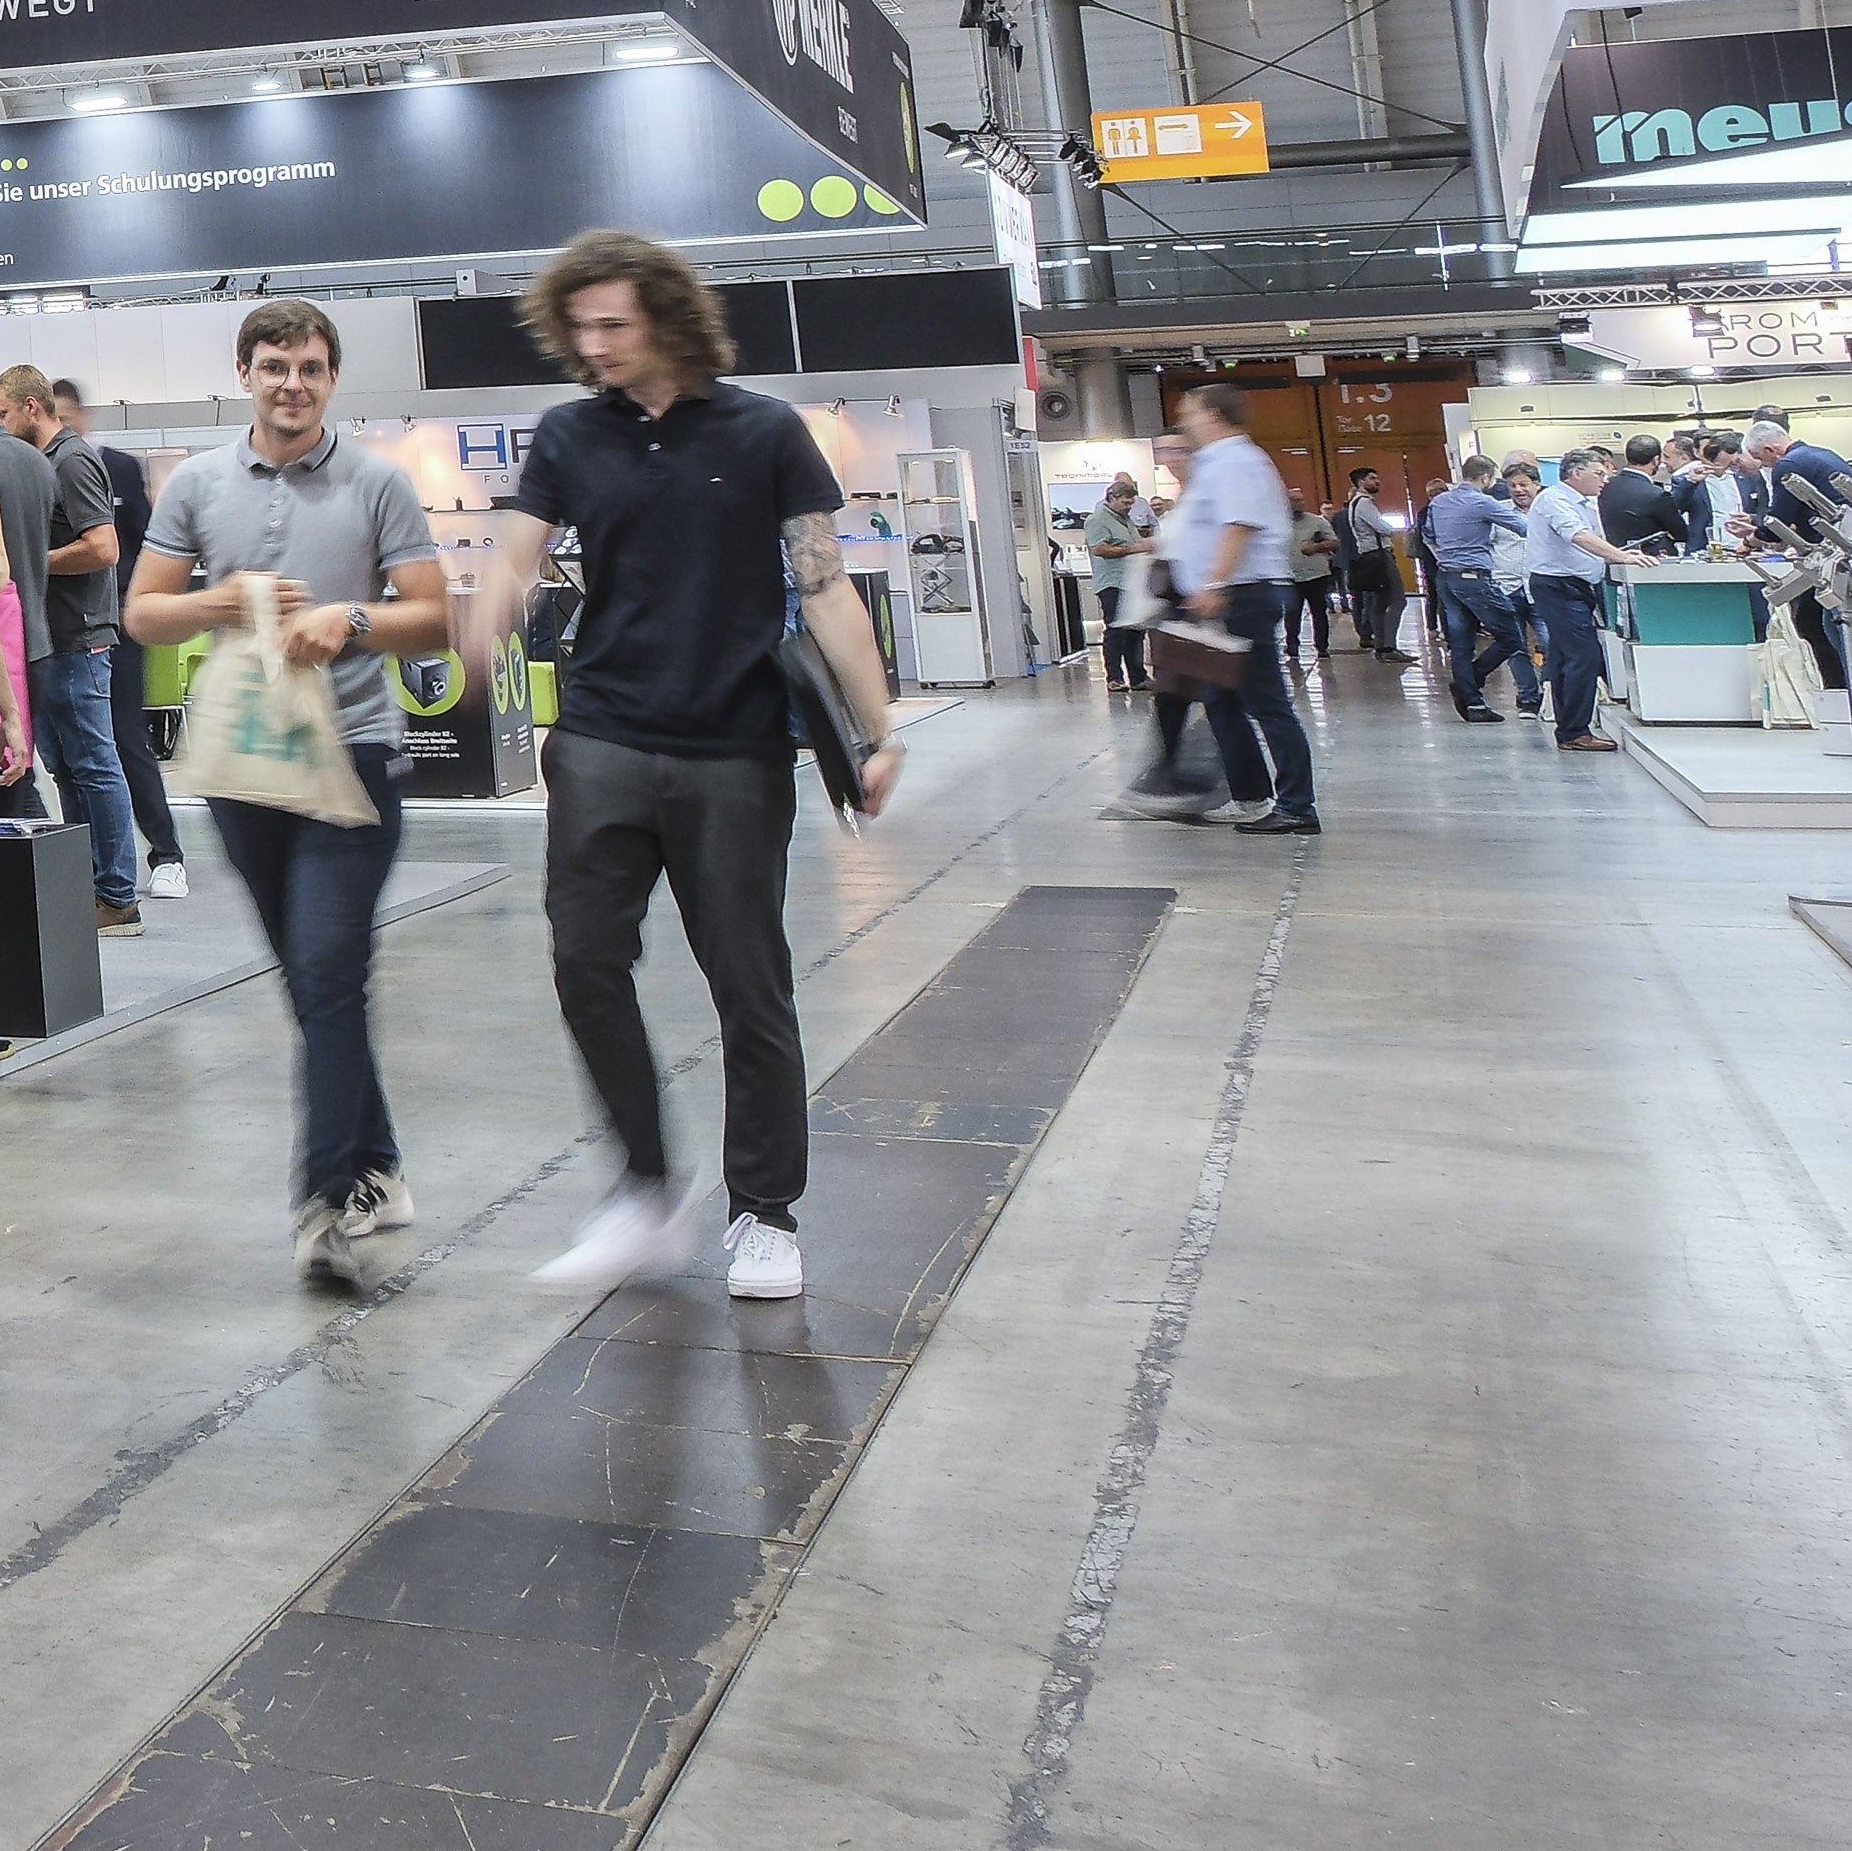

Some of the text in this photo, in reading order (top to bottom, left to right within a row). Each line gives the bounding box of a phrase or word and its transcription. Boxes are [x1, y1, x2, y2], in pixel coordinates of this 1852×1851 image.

[29, 180, 91, 201] unser
[97, 158, 336, 196] Schulungsprogramm
[1364, 413, 1392, 432] 12
